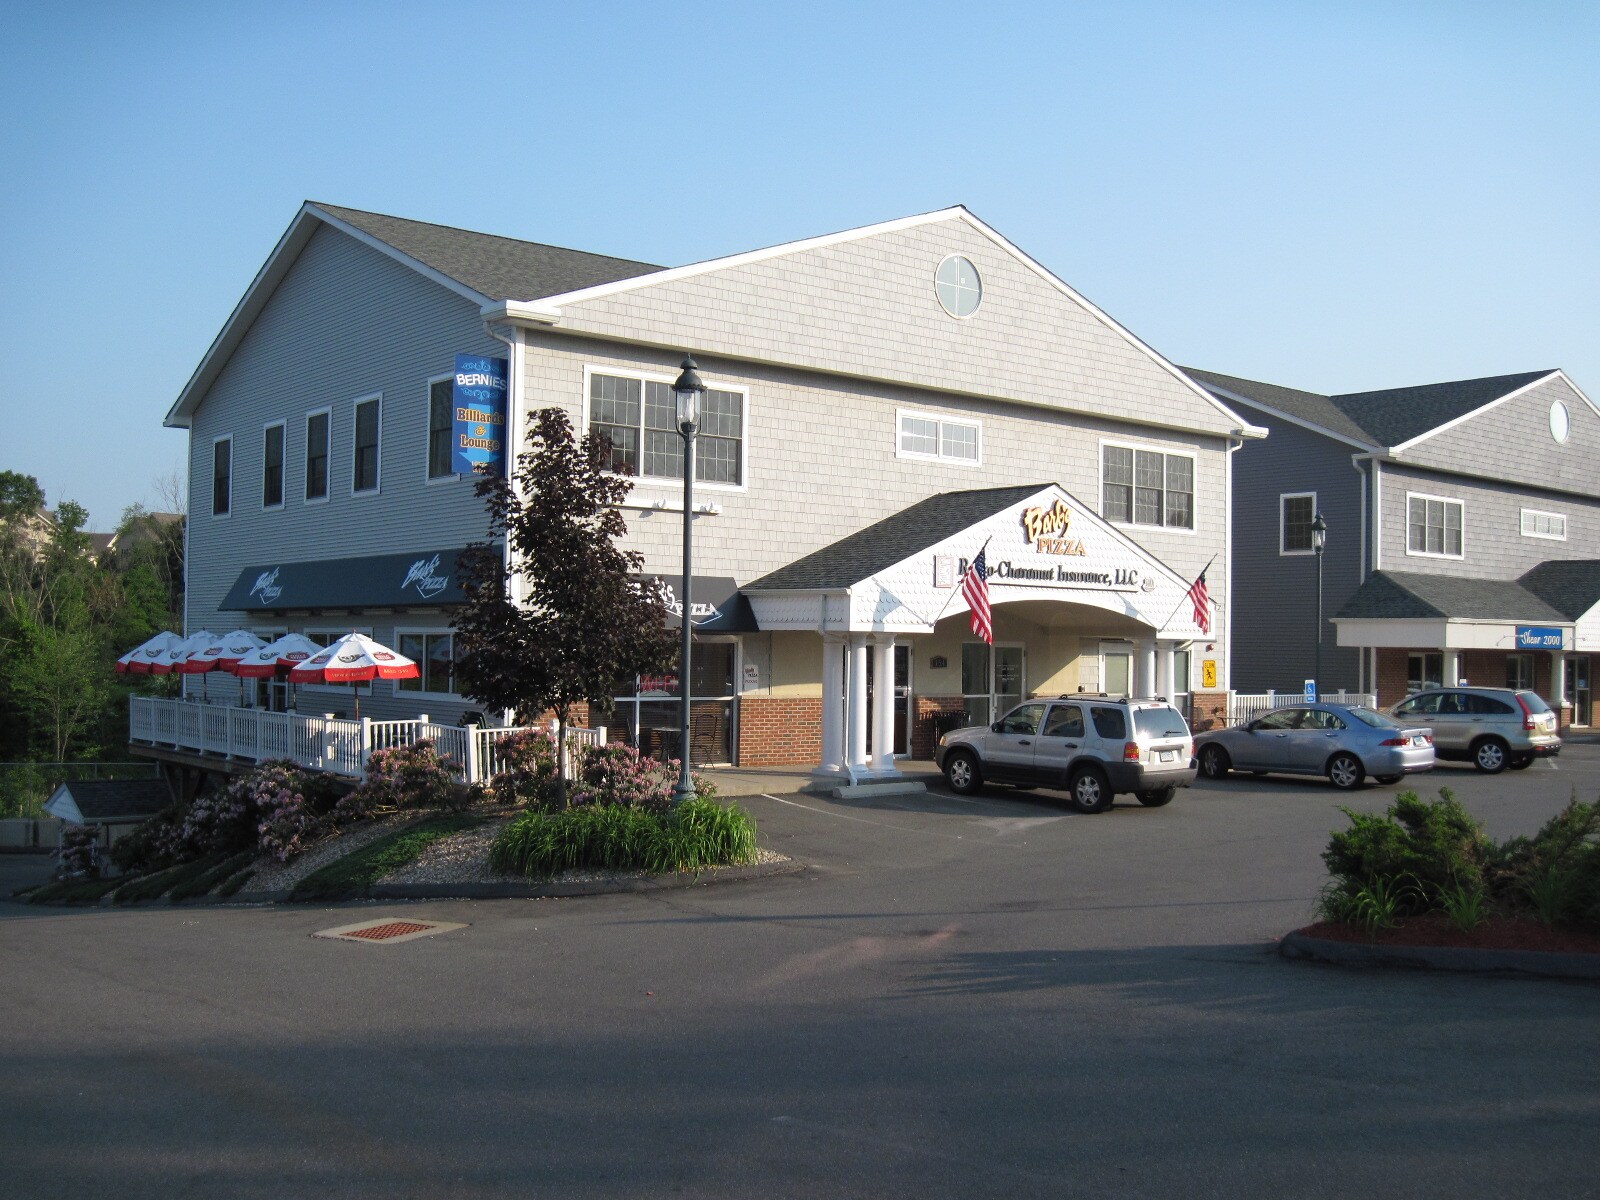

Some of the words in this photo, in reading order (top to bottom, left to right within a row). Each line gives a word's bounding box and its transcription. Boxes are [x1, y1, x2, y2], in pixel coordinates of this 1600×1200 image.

[456, 373, 507, 391] BERNIES
[457, 408, 505, 425] Billiards
[474, 425, 487, 436] &
[460, 434, 500, 452] Lounge
[1037, 537, 1087, 557] PIZZA
[420, 575, 449, 589] PIZZA
[1057, 565, 1112, 586] Insurance,
[1114, 569, 1138, 585] LLC
[675, 602, 721, 616] PZZA
[1521, 629, 1541, 645] Shear
[1543, 635, 1561, 645] 2000
